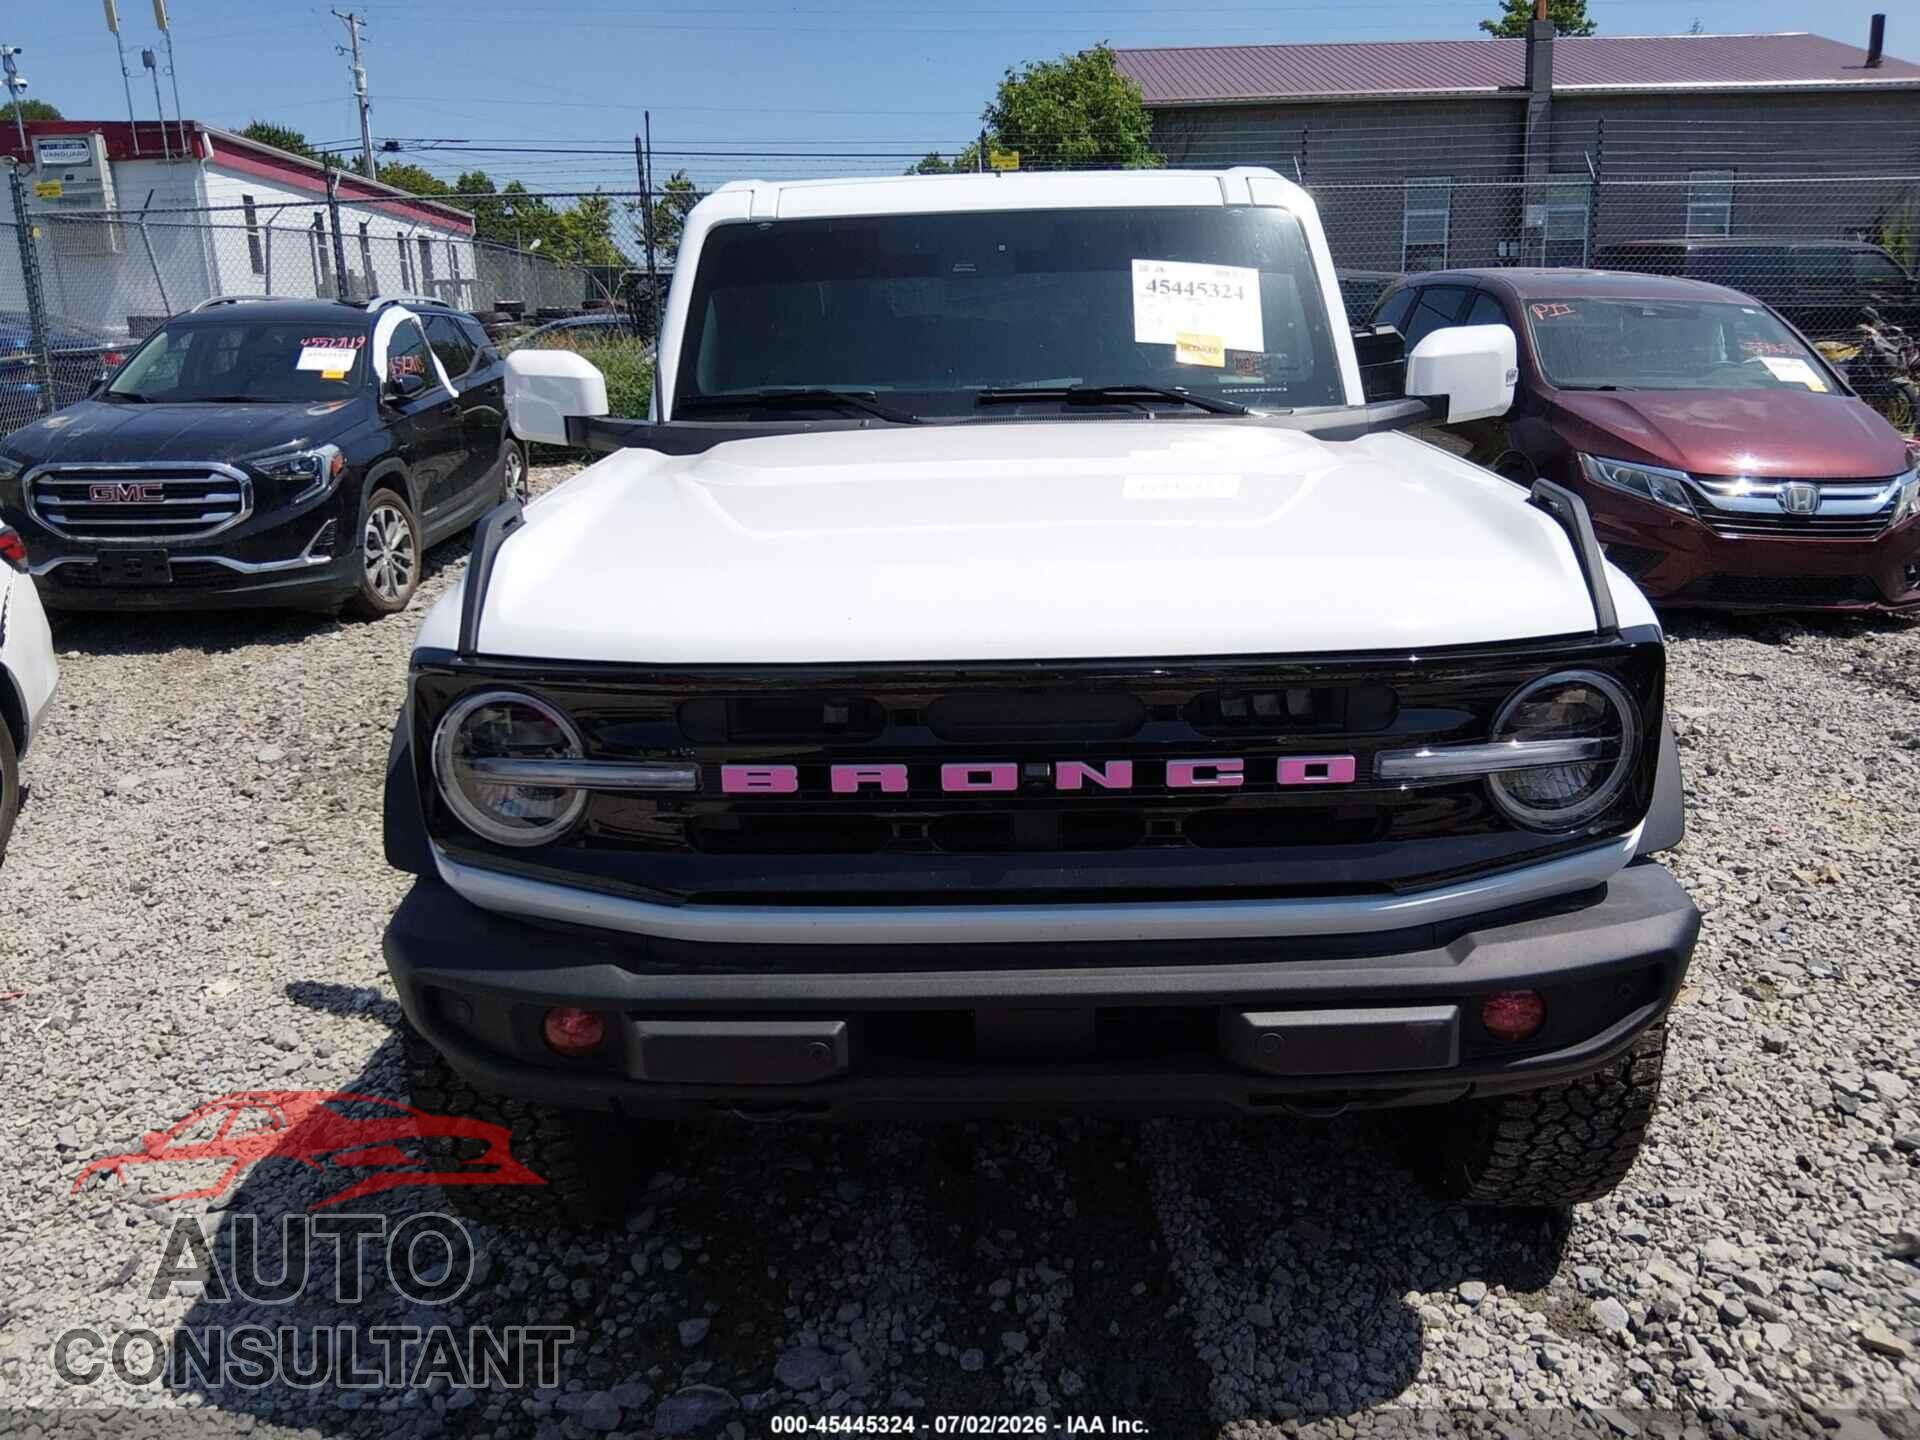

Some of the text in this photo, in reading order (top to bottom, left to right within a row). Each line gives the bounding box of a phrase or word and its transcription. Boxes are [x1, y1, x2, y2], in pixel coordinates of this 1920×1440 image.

[1145, 278, 1245, 301] 45445324
[89, 483, 165, 502] GMC
[721, 754, 1356, 793] BRONCO
